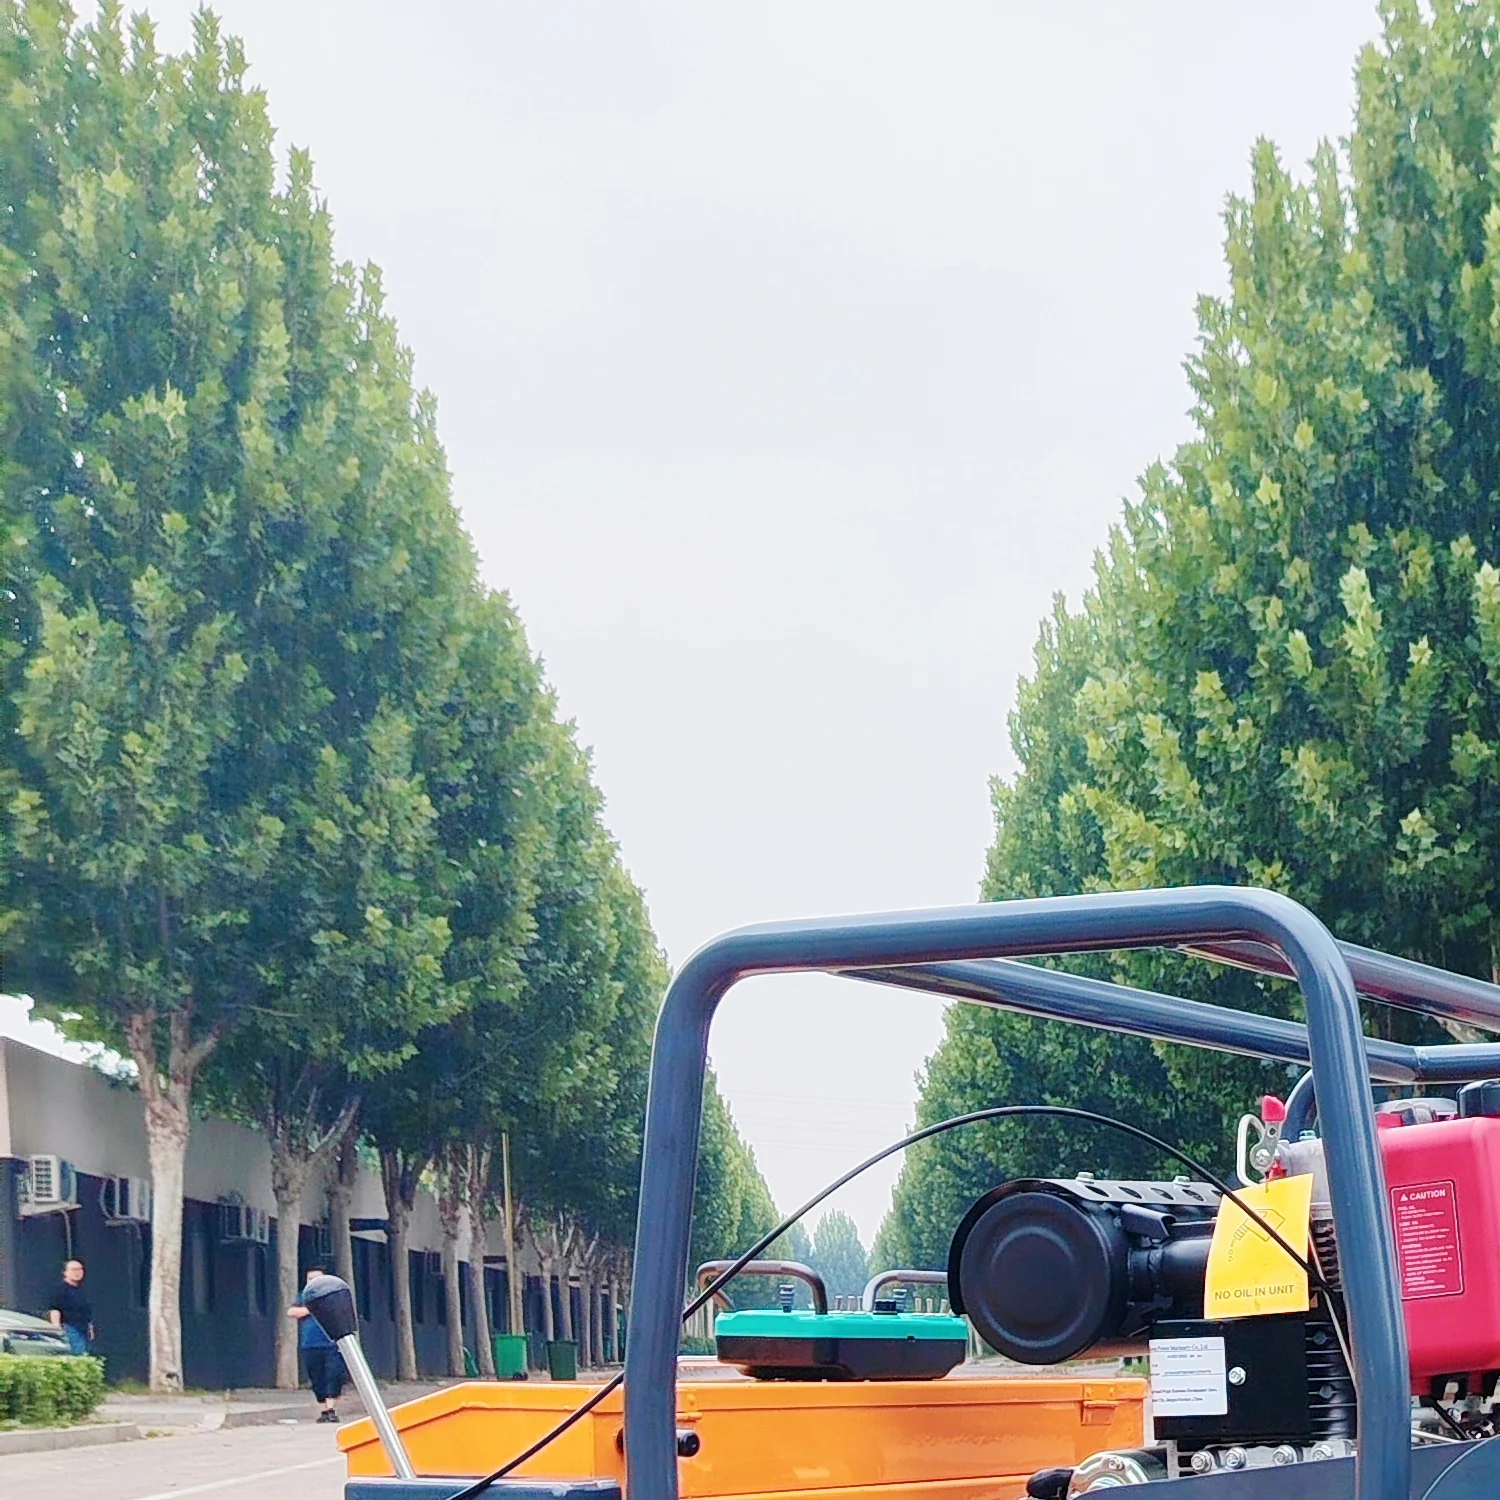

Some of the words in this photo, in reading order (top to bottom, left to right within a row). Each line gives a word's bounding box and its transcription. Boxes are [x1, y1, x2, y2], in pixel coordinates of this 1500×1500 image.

[1409, 1188, 1446, 1201] CAUTION
[1214, 1290, 1231, 1301] NO
[1233, 1288, 1252, 1299] OIL
[1254, 1286, 1266, 1297] IN
[1268, 1284, 1295, 1295] UNIT
